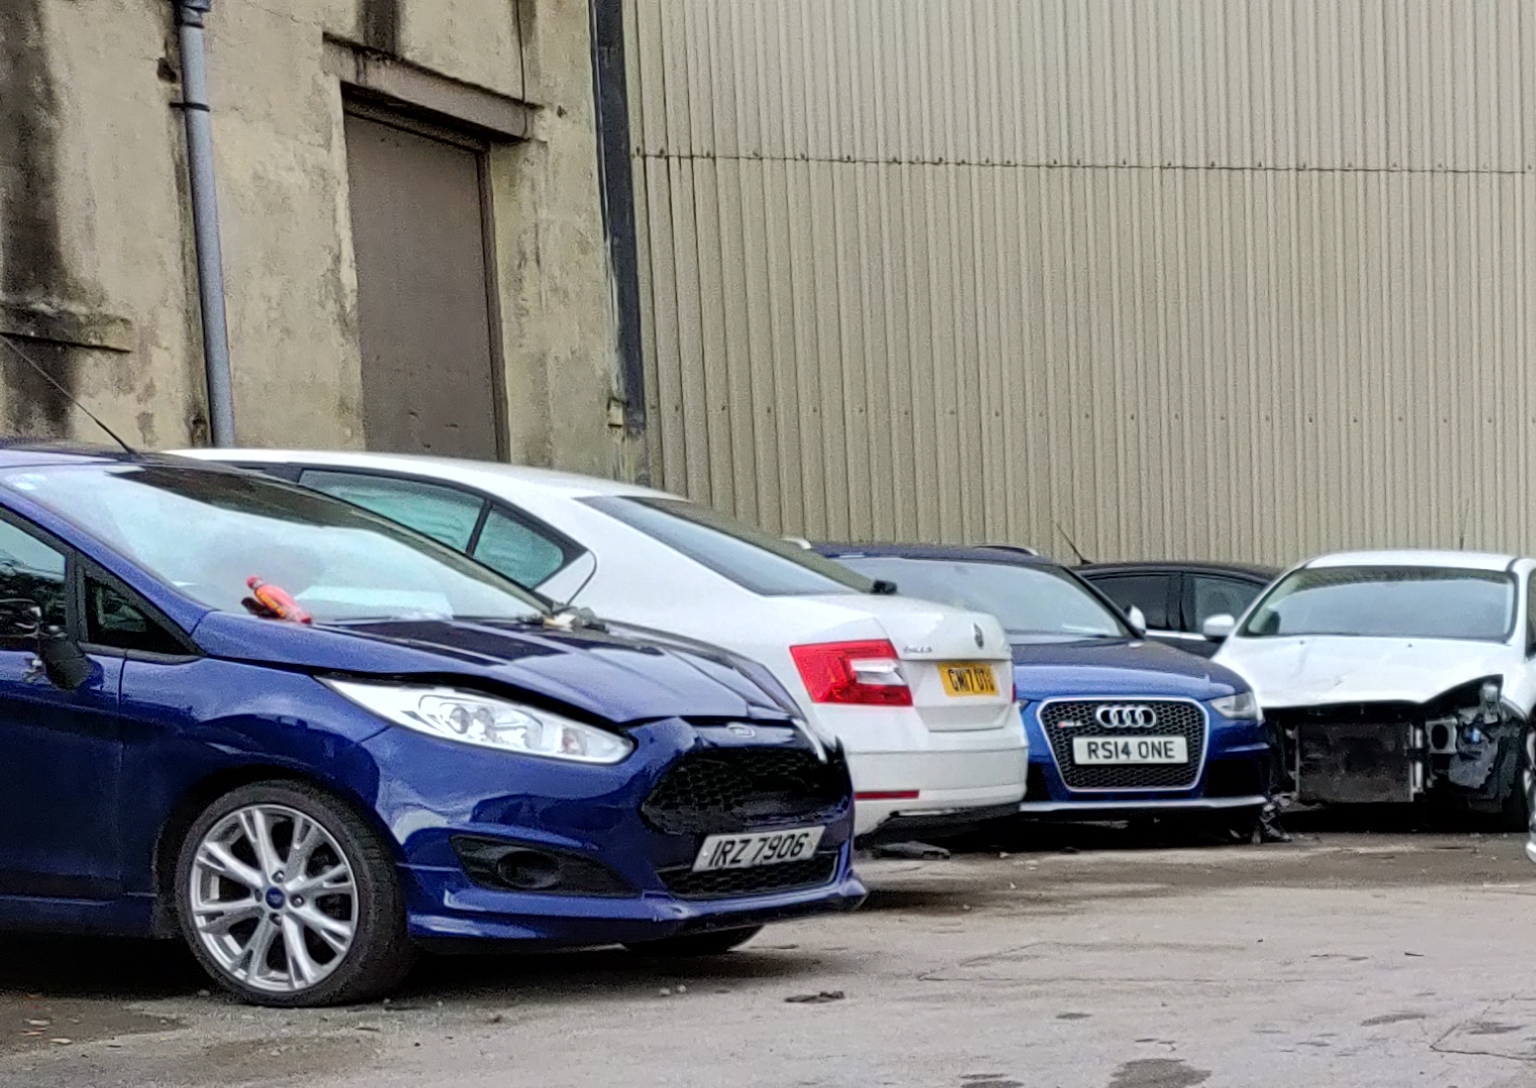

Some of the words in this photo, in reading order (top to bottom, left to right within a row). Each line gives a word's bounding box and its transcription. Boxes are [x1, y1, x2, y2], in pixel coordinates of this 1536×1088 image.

[1086, 741, 1132, 760] RS14
[1137, 740, 1176, 760] ONE
[708, 838, 753, 867] IRZ
[752, 832, 810, 862] 7906
